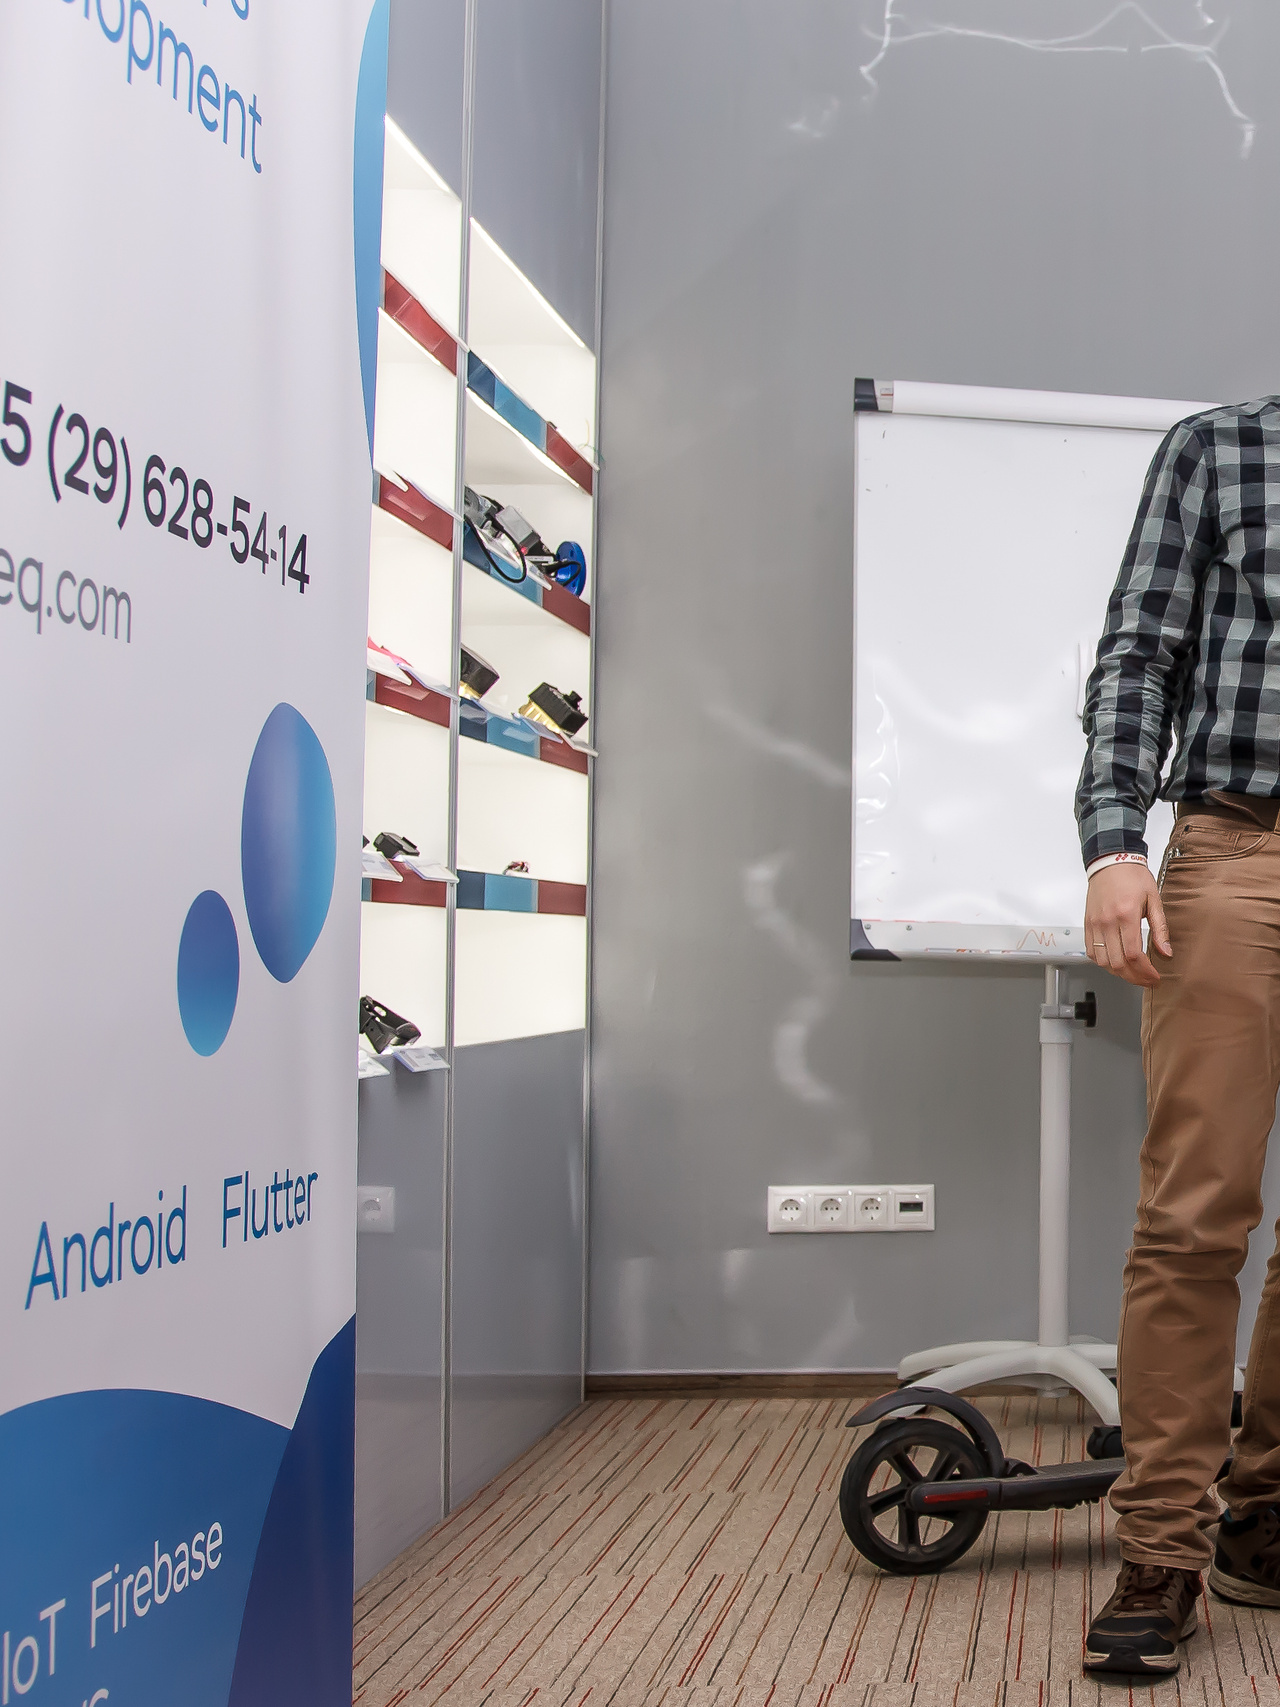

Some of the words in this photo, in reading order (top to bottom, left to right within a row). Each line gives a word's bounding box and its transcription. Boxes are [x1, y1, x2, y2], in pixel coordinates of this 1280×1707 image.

[62, 0, 262, 174] opment
[48, 403, 131, 531] (29)
[143, 454, 310, 595] 628-54-14
[25, 1184, 187, 1311] Android
[222, 1168, 319, 1249] Flutter
[3, 1598, 67, 1706] IoT
[91, 1521, 223, 1649] Firebase
